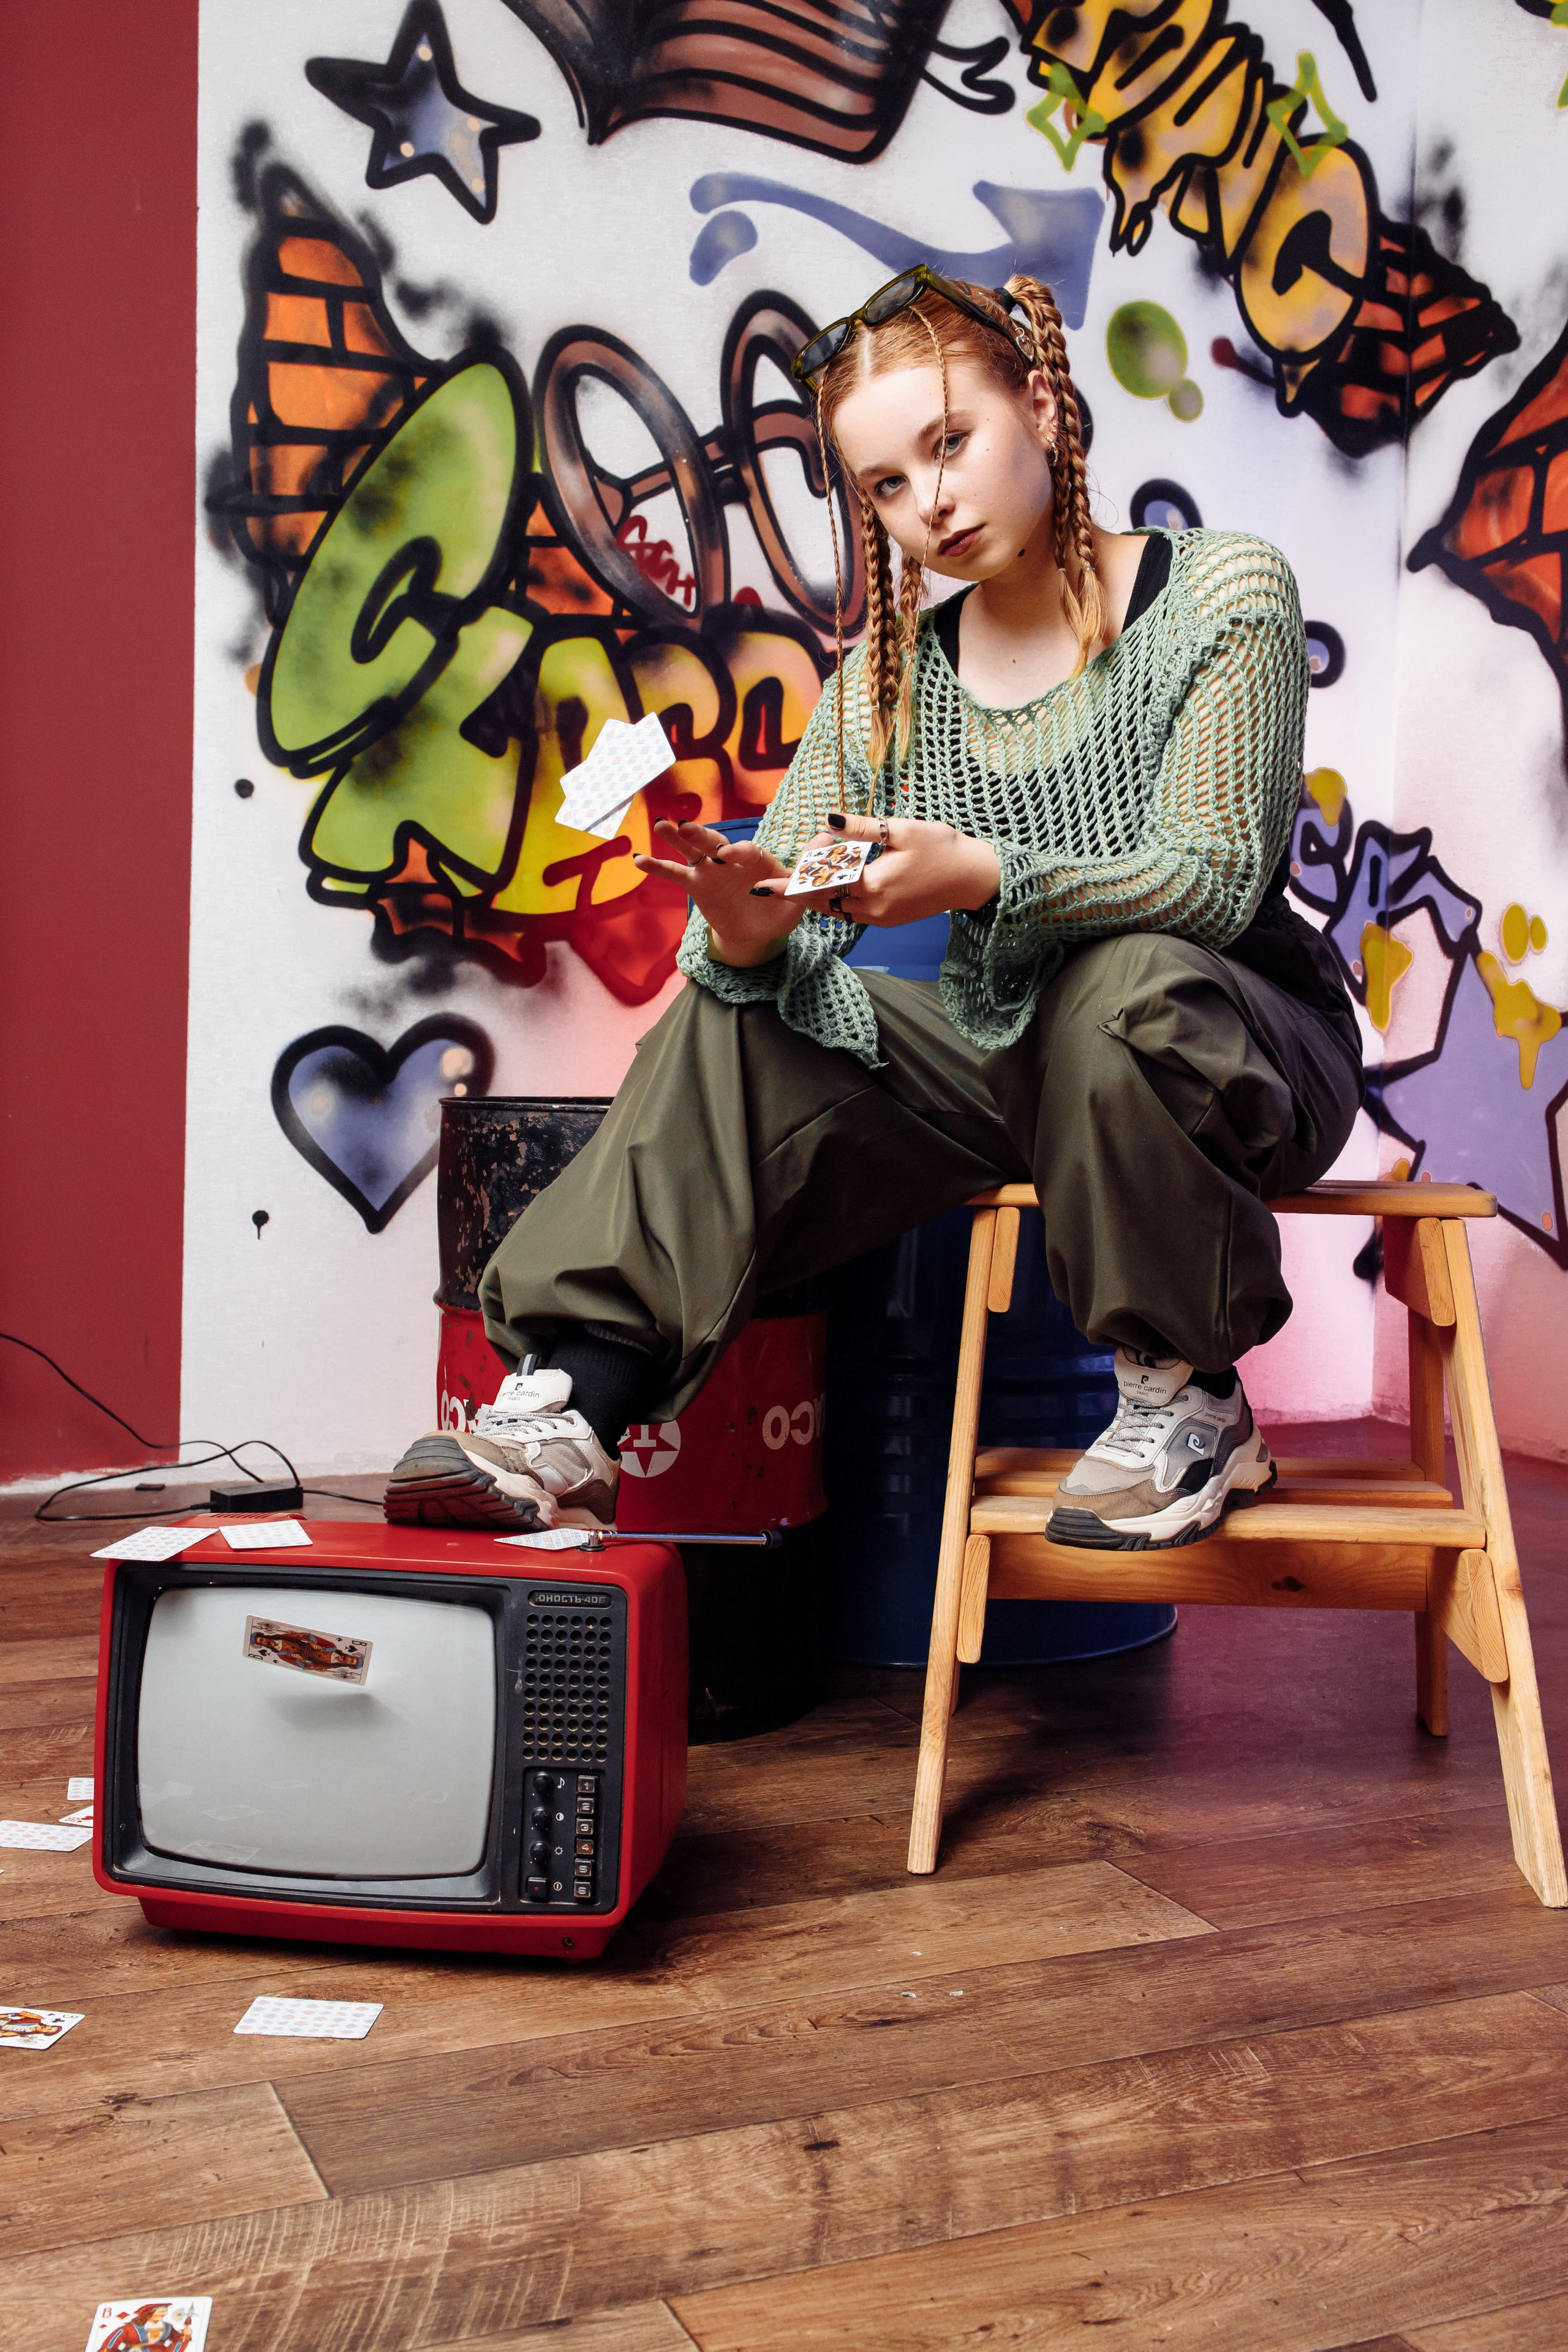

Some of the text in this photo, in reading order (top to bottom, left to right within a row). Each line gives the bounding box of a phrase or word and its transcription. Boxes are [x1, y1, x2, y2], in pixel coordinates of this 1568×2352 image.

[1123, 1380, 1167, 1395] pierre cardin
[517, 1390, 540, 1398] cardin
